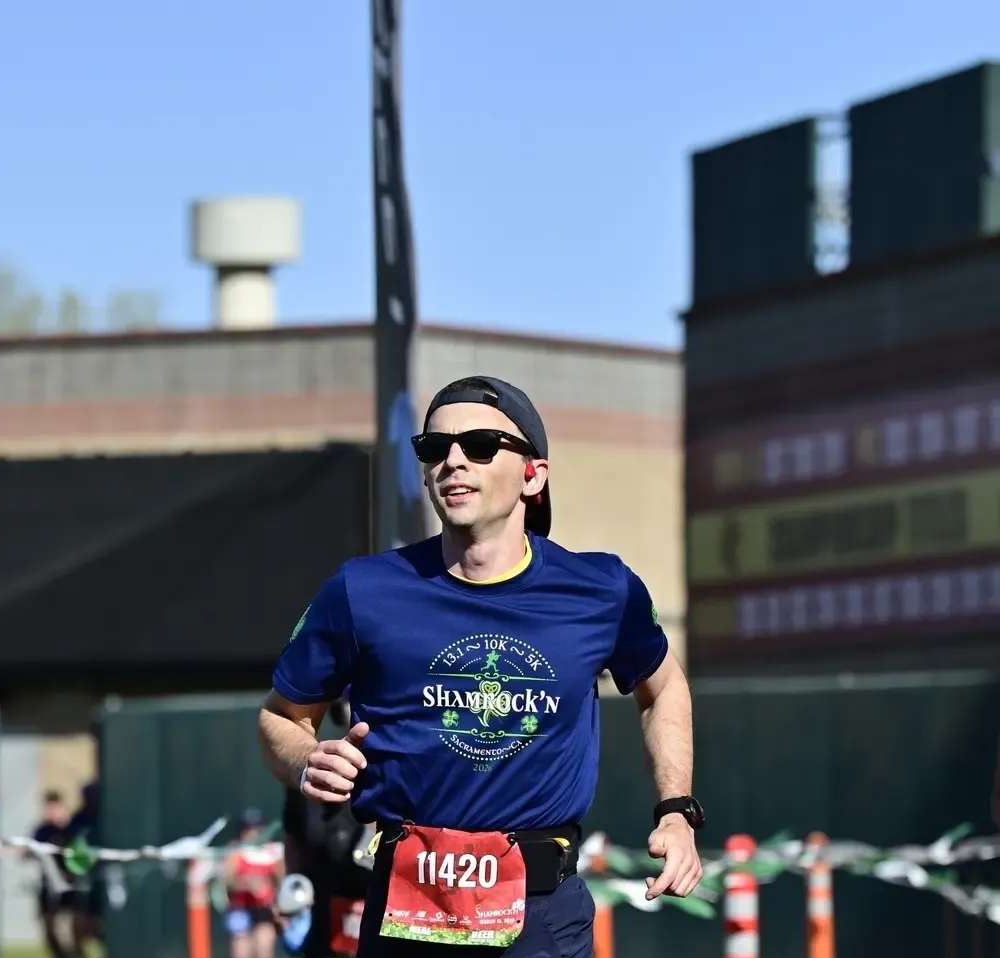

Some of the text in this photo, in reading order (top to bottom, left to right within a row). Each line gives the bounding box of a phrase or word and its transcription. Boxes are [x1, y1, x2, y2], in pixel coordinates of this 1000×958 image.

[442, 639, 543, 671] 13.1 10K 5K
[422, 684, 560, 714] SHAMROCK'N
[450, 734, 502, 756] SACRAMENTO
[416, 851, 498, 889] 11420
[471, 929, 495, 939] BEER
